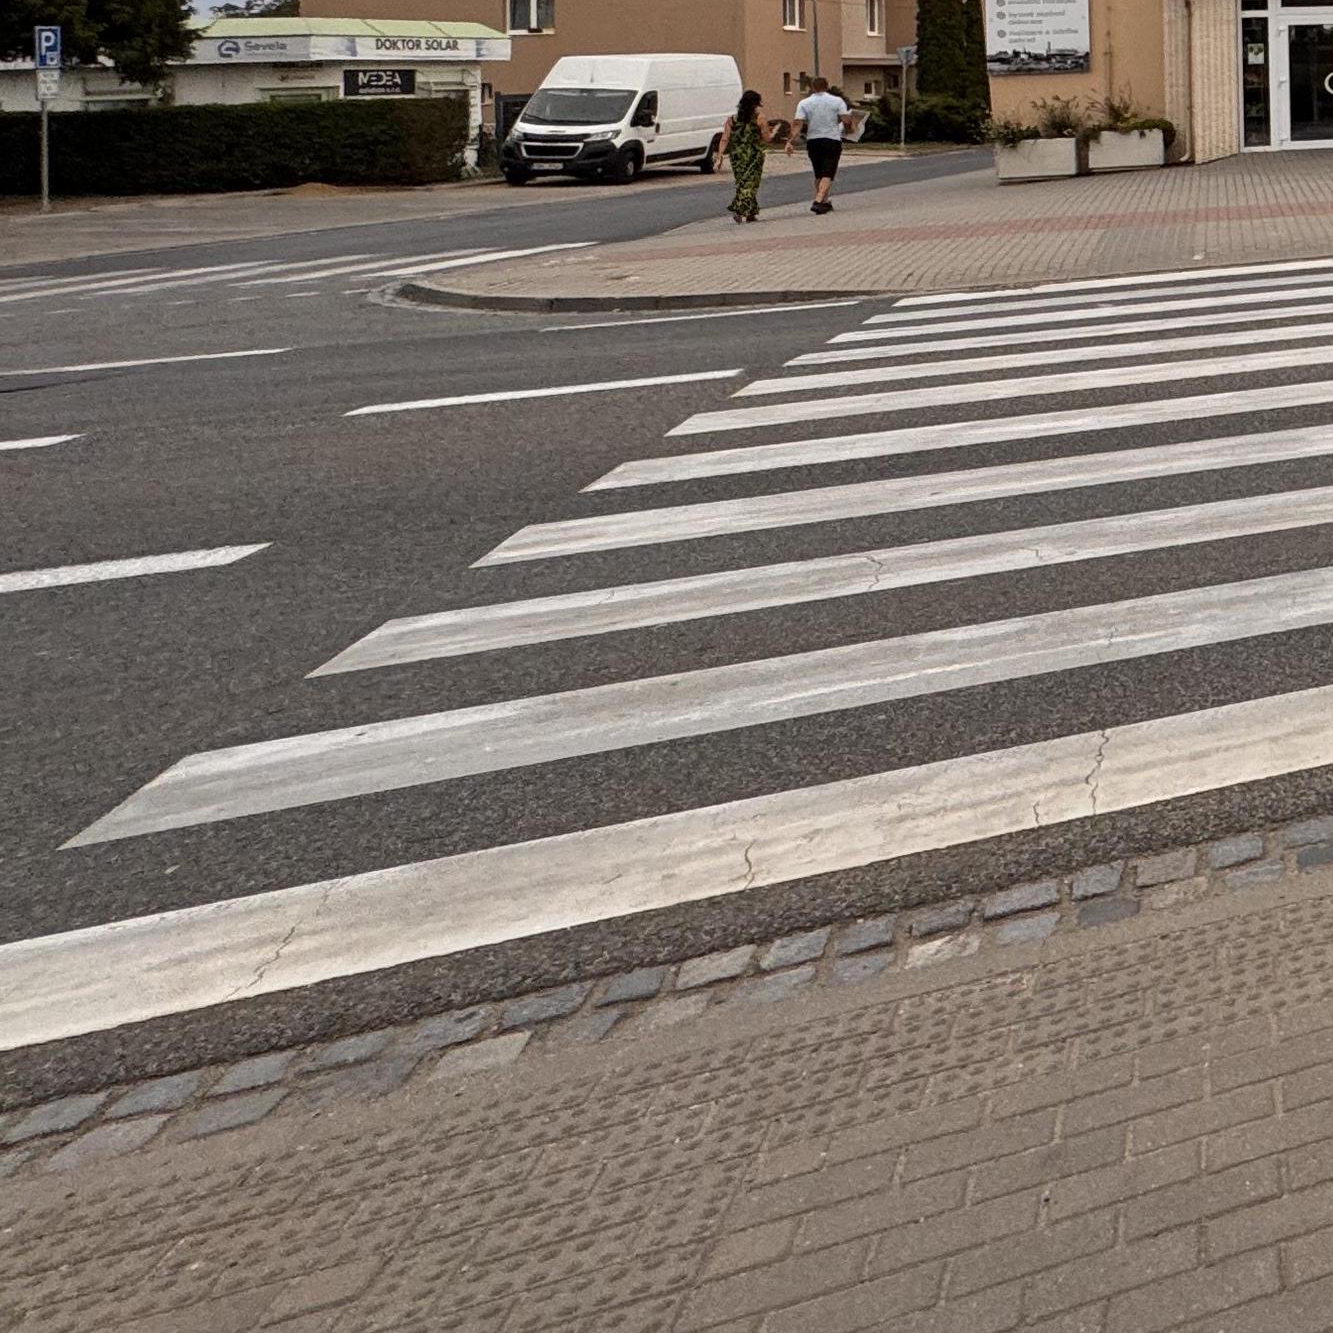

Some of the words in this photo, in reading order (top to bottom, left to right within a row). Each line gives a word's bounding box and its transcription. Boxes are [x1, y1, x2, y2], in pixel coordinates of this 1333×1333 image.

[41, 32, 55, 56] P
[375, 38, 422, 51] DOKTOR
[425, 39, 459, 51] SOLAR
[358, 71, 401, 86] MEDEA
